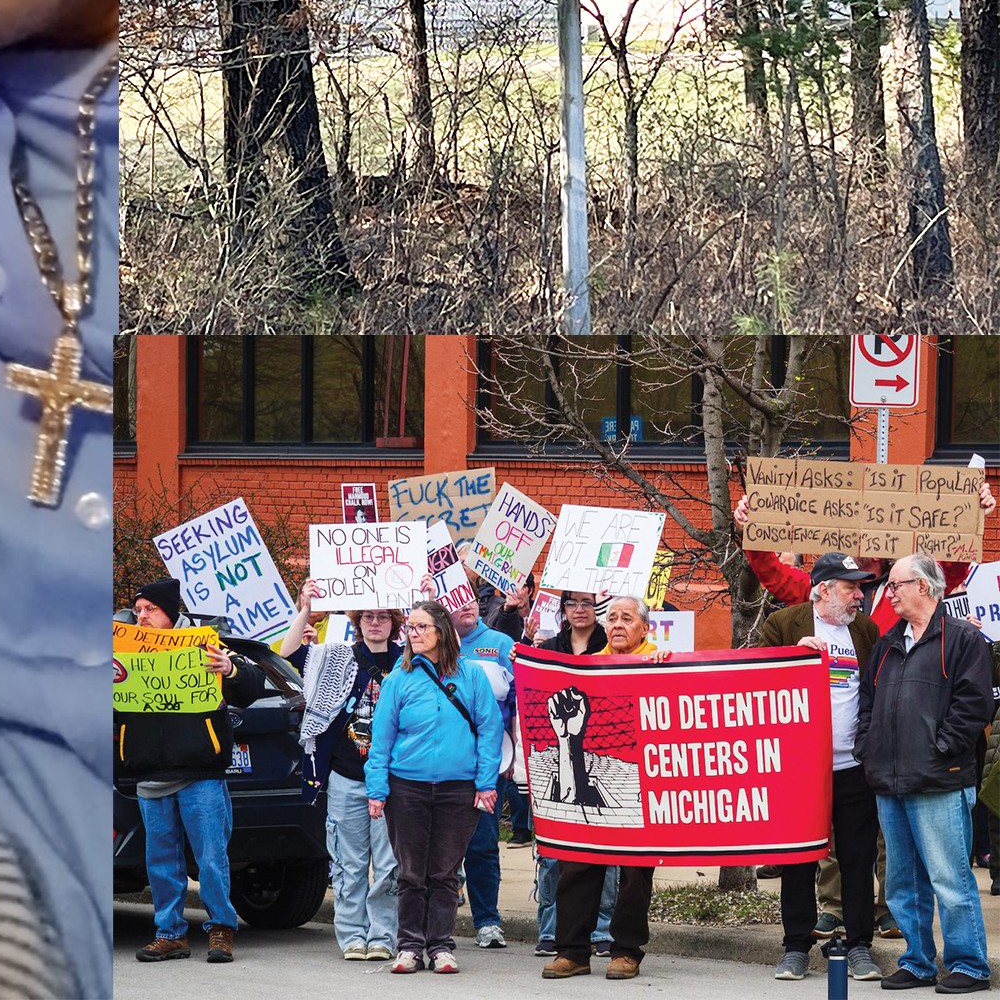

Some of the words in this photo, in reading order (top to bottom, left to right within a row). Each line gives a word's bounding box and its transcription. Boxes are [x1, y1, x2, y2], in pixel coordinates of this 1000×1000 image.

[390, 479, 454, 508] FUCK
[454, 473, 491, 497] THE
[498, 492, 551, 538] HANDS
[564, 510, 598, 539] WE
[601, 513, 648, 543] ARE
[157, 505, 248, 560] SEEKING
[317, 528, 347, 547] NO
[352, 527, 389, 545] ONE
[395, 526, 411, 544] IS
[496, 520, 534, 551] OFF
[182, 525, 261, 582] ASYLUM
[336, 545, 410, 565] ILLEGAL
[473, 541, 526, 583] IMMIGRANT
[494, 543, 514, 563] OUR
[551, 541, 587, 567] NOT
[186, 582, 210, 607] IS
[215, 552, 263, 591] NOT
[354, 565, 377, 578] ON
[475, 560, 517, 593] FRIENDS
[556, 568, 570, 588] A
[585, 568, 643, 595] THREAT
[316, 577, 375, 598] STOLEN
[376, 588, 425, 608] LAND
[225, 593, 240, 613] A
[227, 582, 293, 635] RIME!
[134, 630, 216, 647] DETENTIONS
[131, 658, 155, 671] HEY
[170, 649, 204, 671] ICE!
[141, 676, 170, 690] YOU
[176, 672, 215, 689] SOLD
[113, 691, 139, 704] OUR
[142, 692, 183, 704] SOUL
[191, 687, 218, 704] FOR
[143, 703, 154, 712] A
[156, 702, 181, 711] JOB
[638, 696, 672, 731] NO
[678, 687, 810, 730] DETENTION
[643, 739, 749, 778] CENTERS
[755, 737, 782, 774] IN
[647, 786, 770, 825] MICHIGAN
